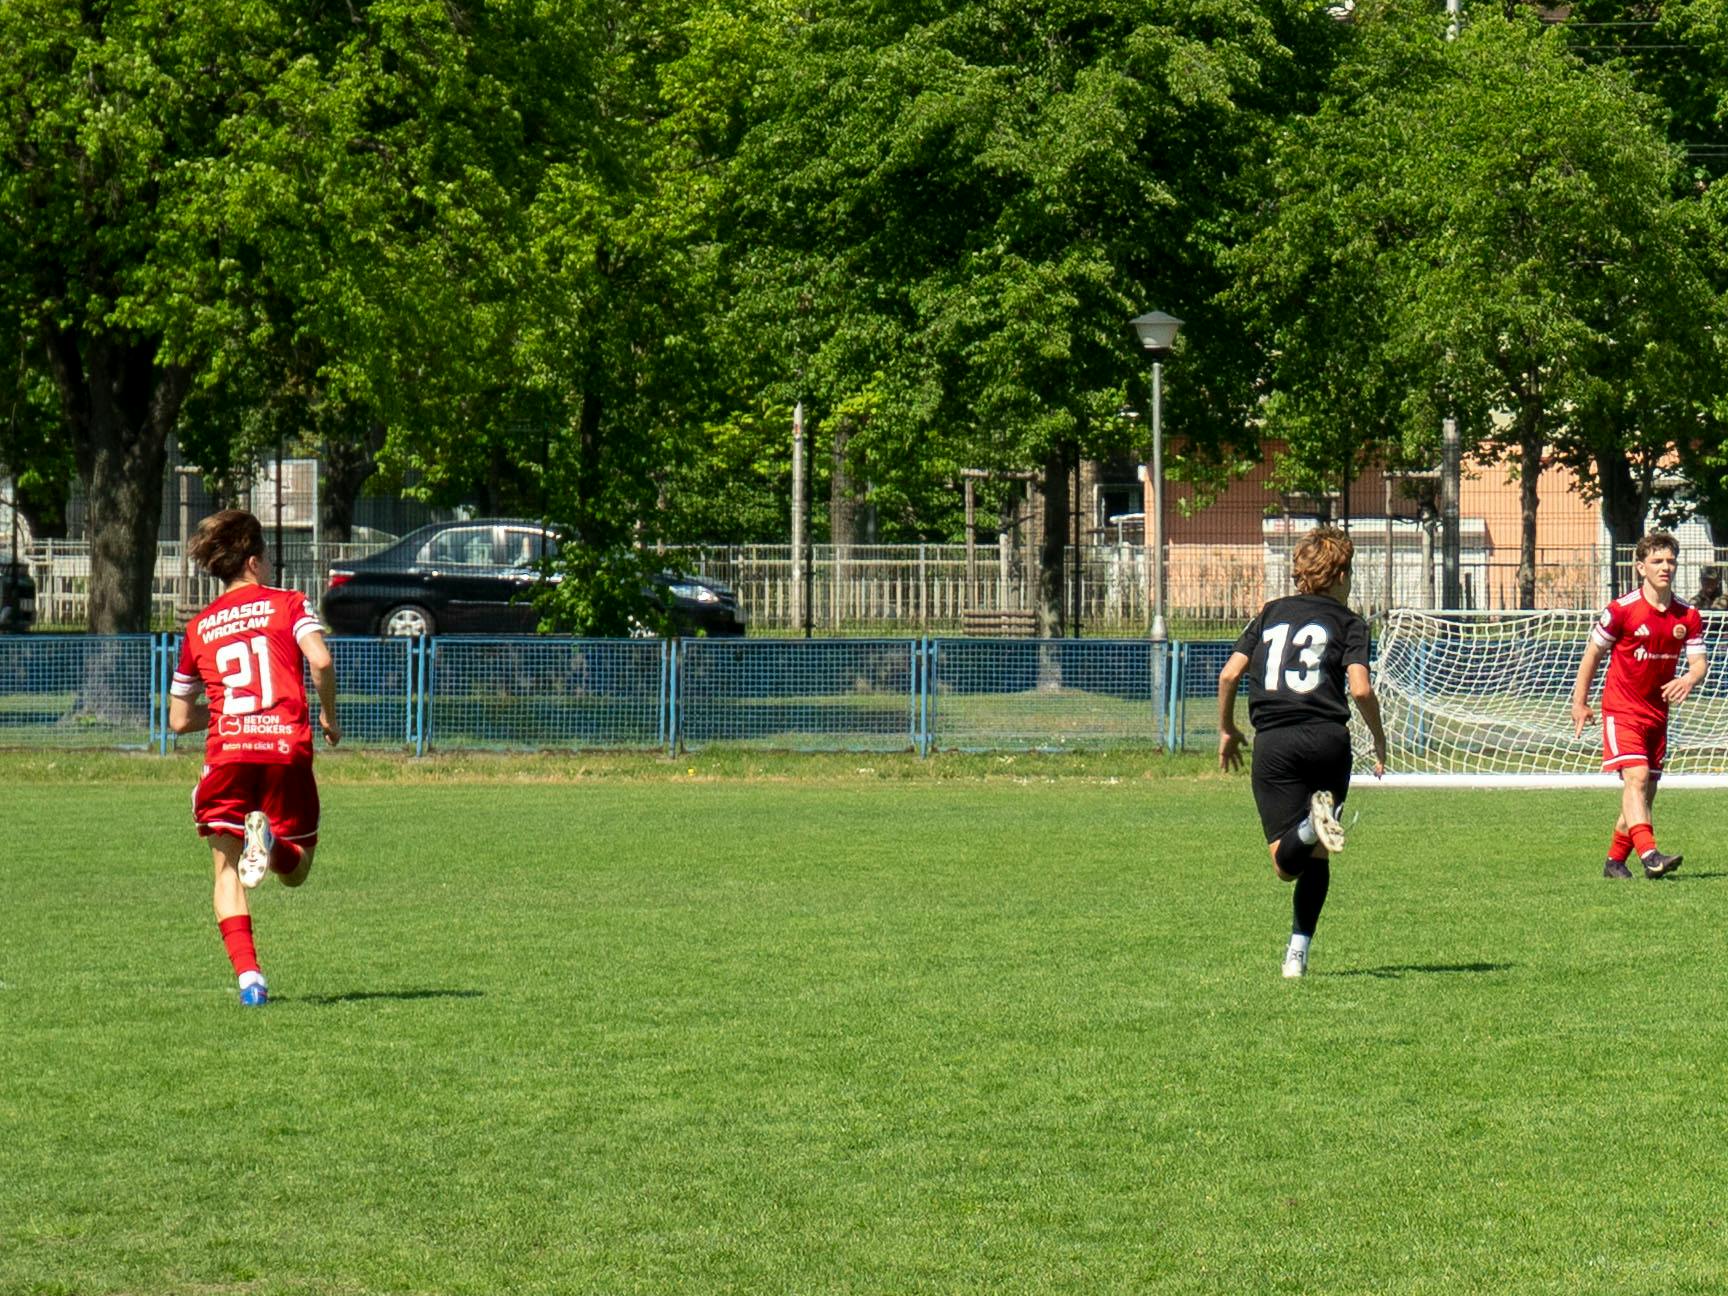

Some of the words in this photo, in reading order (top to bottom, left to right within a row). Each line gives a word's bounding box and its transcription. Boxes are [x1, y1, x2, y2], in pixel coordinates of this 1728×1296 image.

[197, 599, 276, 635] PARASOL
[202, 616, 270, 644] WROCŁAW
[1262, 622, 1329, 693] 13
[215, 635, 273, 715] 21
[243, 714, 281, 724] BETON
[243, 724, 292, 734] BROKERS
